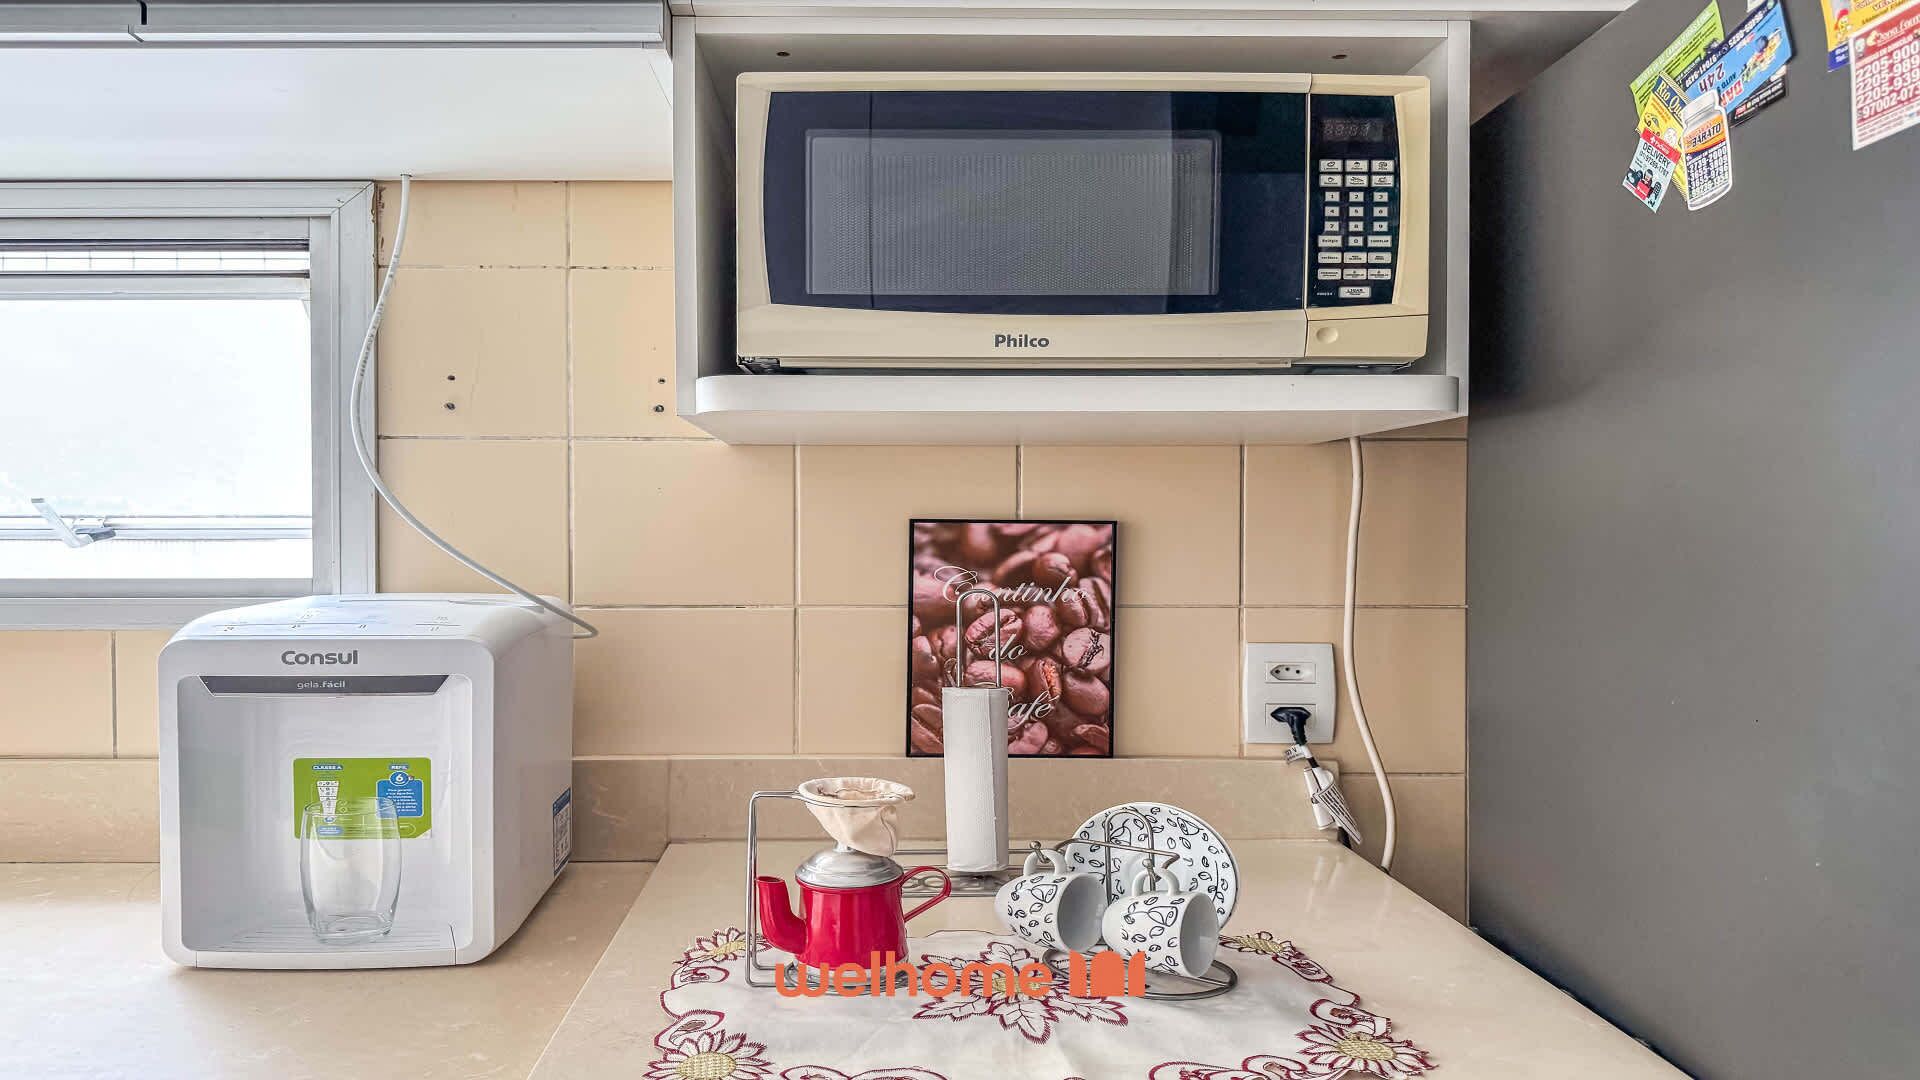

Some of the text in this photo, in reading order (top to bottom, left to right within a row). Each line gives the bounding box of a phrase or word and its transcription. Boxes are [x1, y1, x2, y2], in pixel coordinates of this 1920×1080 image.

[1656, 79, 1670, 100] Rio
[1643, 141, 1671, 168] DELIVERY
[994, 333, 1050, 348] Philco
[934, 565, 1089, 602] Cantinho
[988, 633, 1028, 660] do
[281, 650, 358, 666] Consul
[297, 680, 346, 690] gela.fácil
[395, 774, 404, 782] 6
